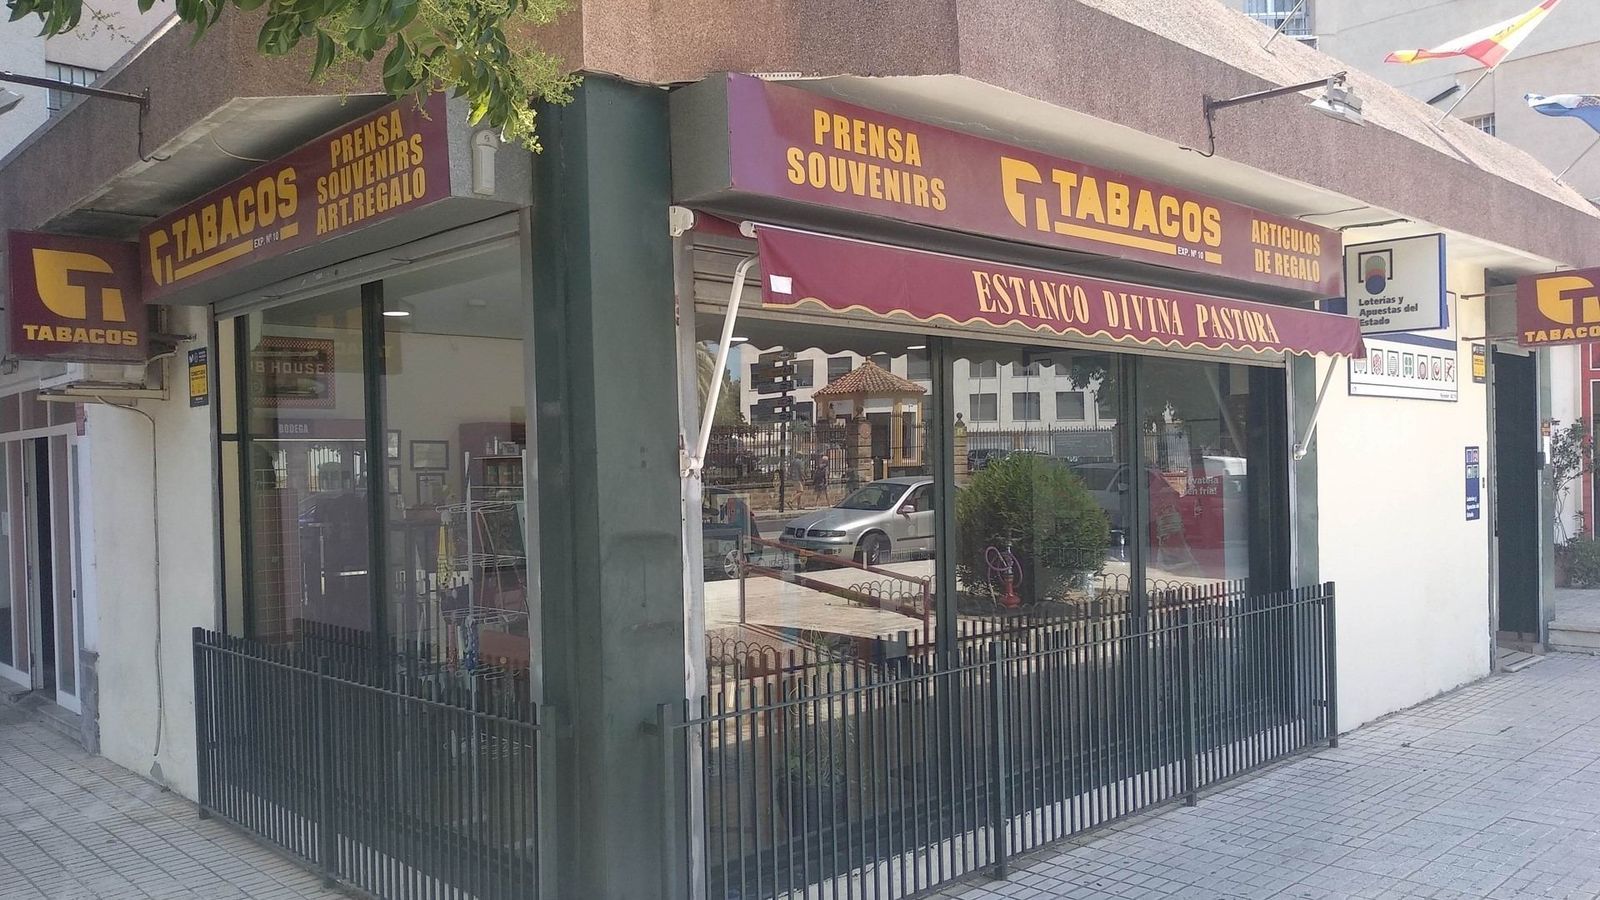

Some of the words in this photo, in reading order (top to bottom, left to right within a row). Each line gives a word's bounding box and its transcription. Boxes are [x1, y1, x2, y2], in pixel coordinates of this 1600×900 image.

[330, 109, 404, 167] PRENSA
[813, 109, 922, 168] PRENSA
[316, 133, 424, 202] SOUVENIRS
[786, 147, 947, 211] SOUVENIRS
[171, 166, 298, 263] TABACOS
[316, 166, 426, 236] ART.REGALO
[1052, 168, 1222, 248] TABACOS
[1177, 246, 1190, 257] EXP.
[1251, 219, 1321, 257] ARTICULOS
[1254, 248, 1273, 274] DE
[1275, 251, 1321, 283] REGALO
[972, 269, 1089, 324] ESTANCO
[1102, 290, 1185, 336] DIVINA
[1195, 303, 1280, 344] PASTORA
[1359, 305, 1402, 318] Apuestas
[1404, 303, 1419, 313] del
[1398, 296, 1404, 305] y
[22, 325, 139, 346] TABACOS
[1360, 316, 1391, 327] Estado
[1524, 325, 1600, 343] TABACO
[271, 361, 326, 376] HOUSE
